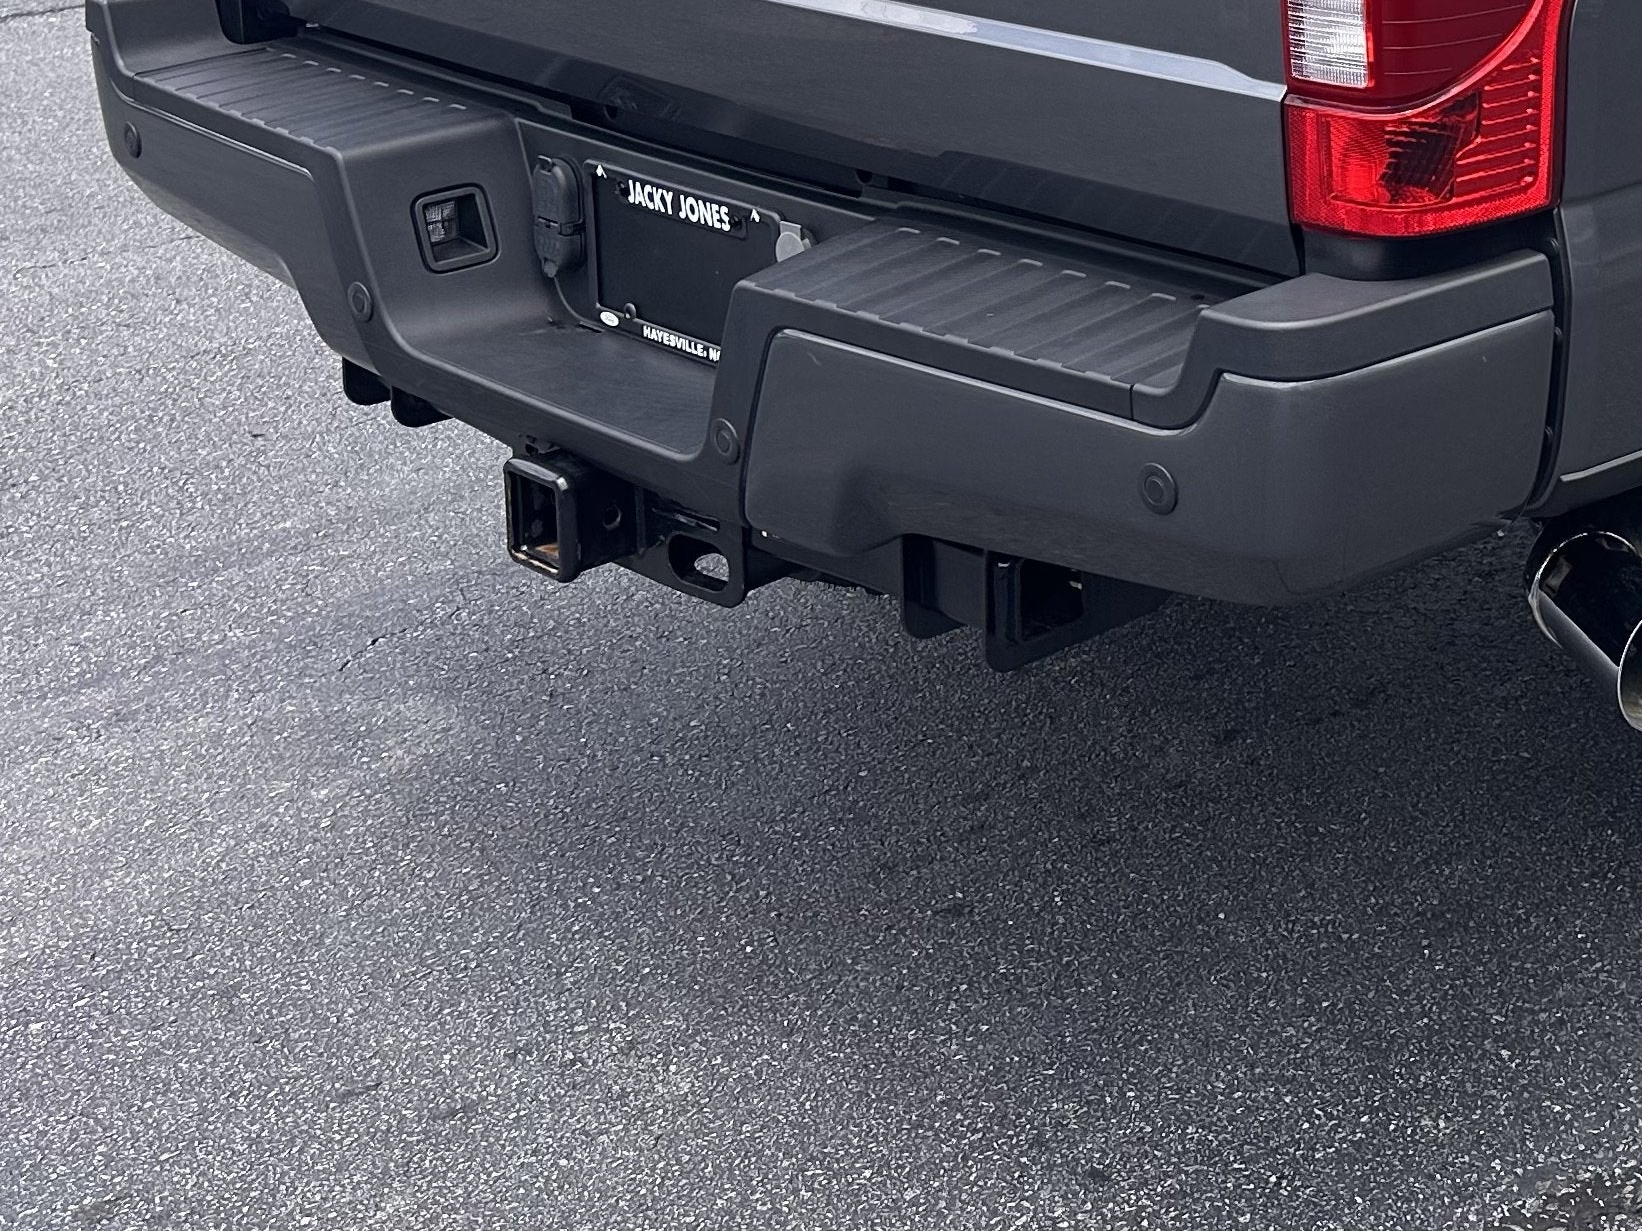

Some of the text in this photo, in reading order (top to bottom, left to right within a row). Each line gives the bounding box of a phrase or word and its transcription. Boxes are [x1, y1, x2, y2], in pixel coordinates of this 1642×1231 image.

[627, 179, 731, 232] JACKY JONES
[642, 325, 721, 362] HAYESVILLE, N
